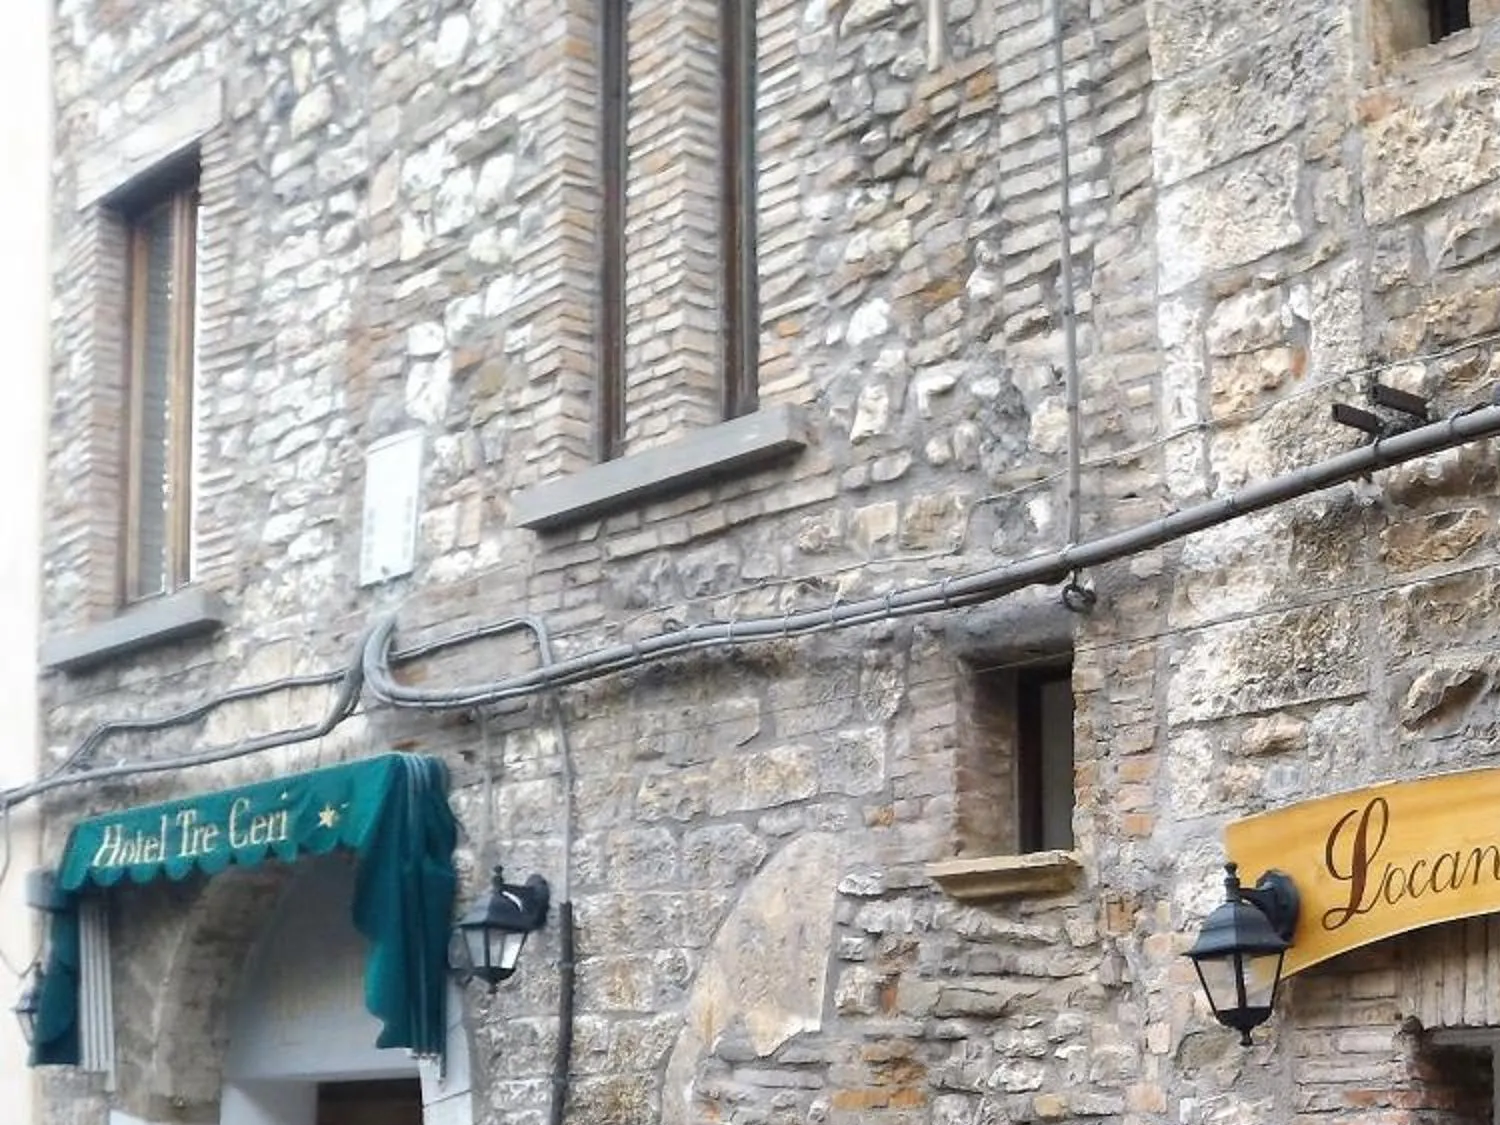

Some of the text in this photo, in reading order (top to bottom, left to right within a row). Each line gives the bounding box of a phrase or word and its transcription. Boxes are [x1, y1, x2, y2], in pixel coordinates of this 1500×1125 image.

[92, 791, 290, 867] Hotel Tre Ceri
